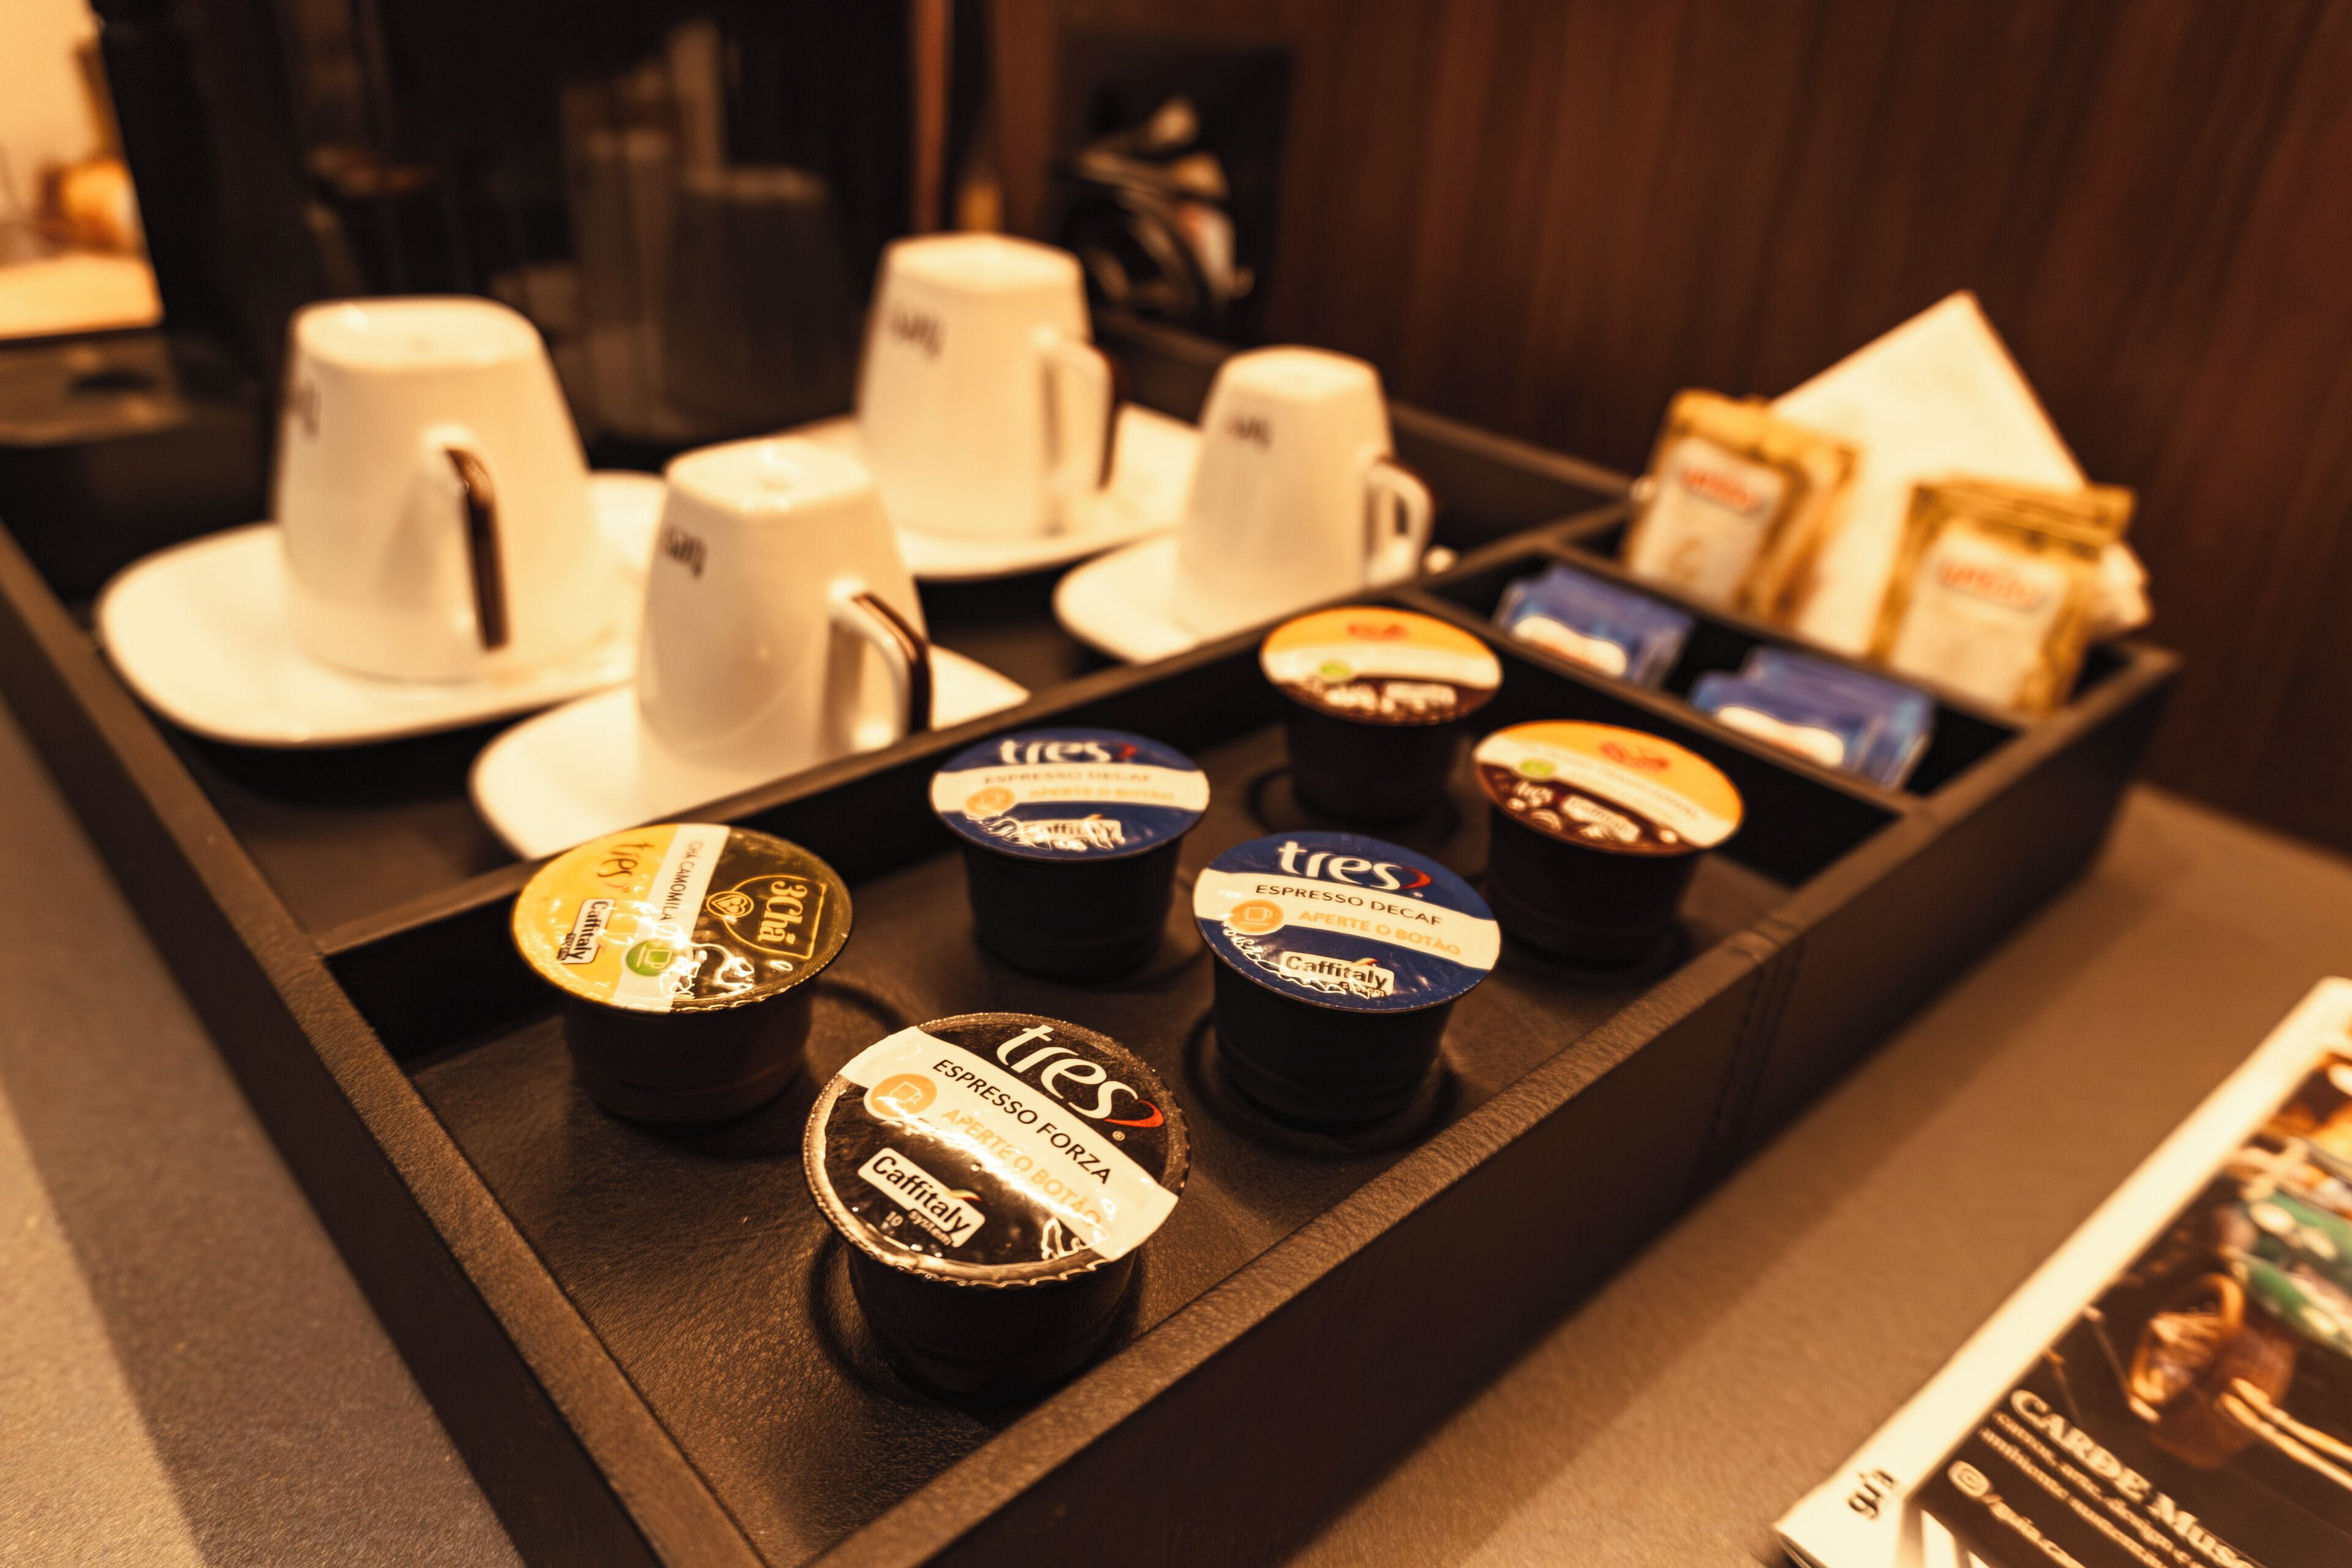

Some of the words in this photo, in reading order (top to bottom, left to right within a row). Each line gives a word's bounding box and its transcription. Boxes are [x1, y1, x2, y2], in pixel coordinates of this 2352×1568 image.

[659, 861, 695, 921] CAMOMILA
[1277, 841, 1403, 891] tres
[566, 900, 609, 960] Caffitaly
[757, 880, 808, 944] 3Chá
[1255, 884, 1364, 907] ESPRESSO
[1370, 900, 1442, 925] DECAF
[1298, 910, 1371, 932] APERTE
[1376, 924, 1391, 936] O
[1395, 928, 1461, 956] BOTÃO
[1286, 956, 1389, 989] Caffitaly
[996, 1024, 1139, 1120] tres
[932, 1059, 1038, 1125] ESPRESSO
[1036, 1122, 1112, 1185] FORZA
[940, 1109, 1017, 1160] APERTE
[1014, 1156, 1034, 1172] O
[872, 1156, 971, 1234] Caffitaly
[2009, 1389, 2153, 1504] CARDE
